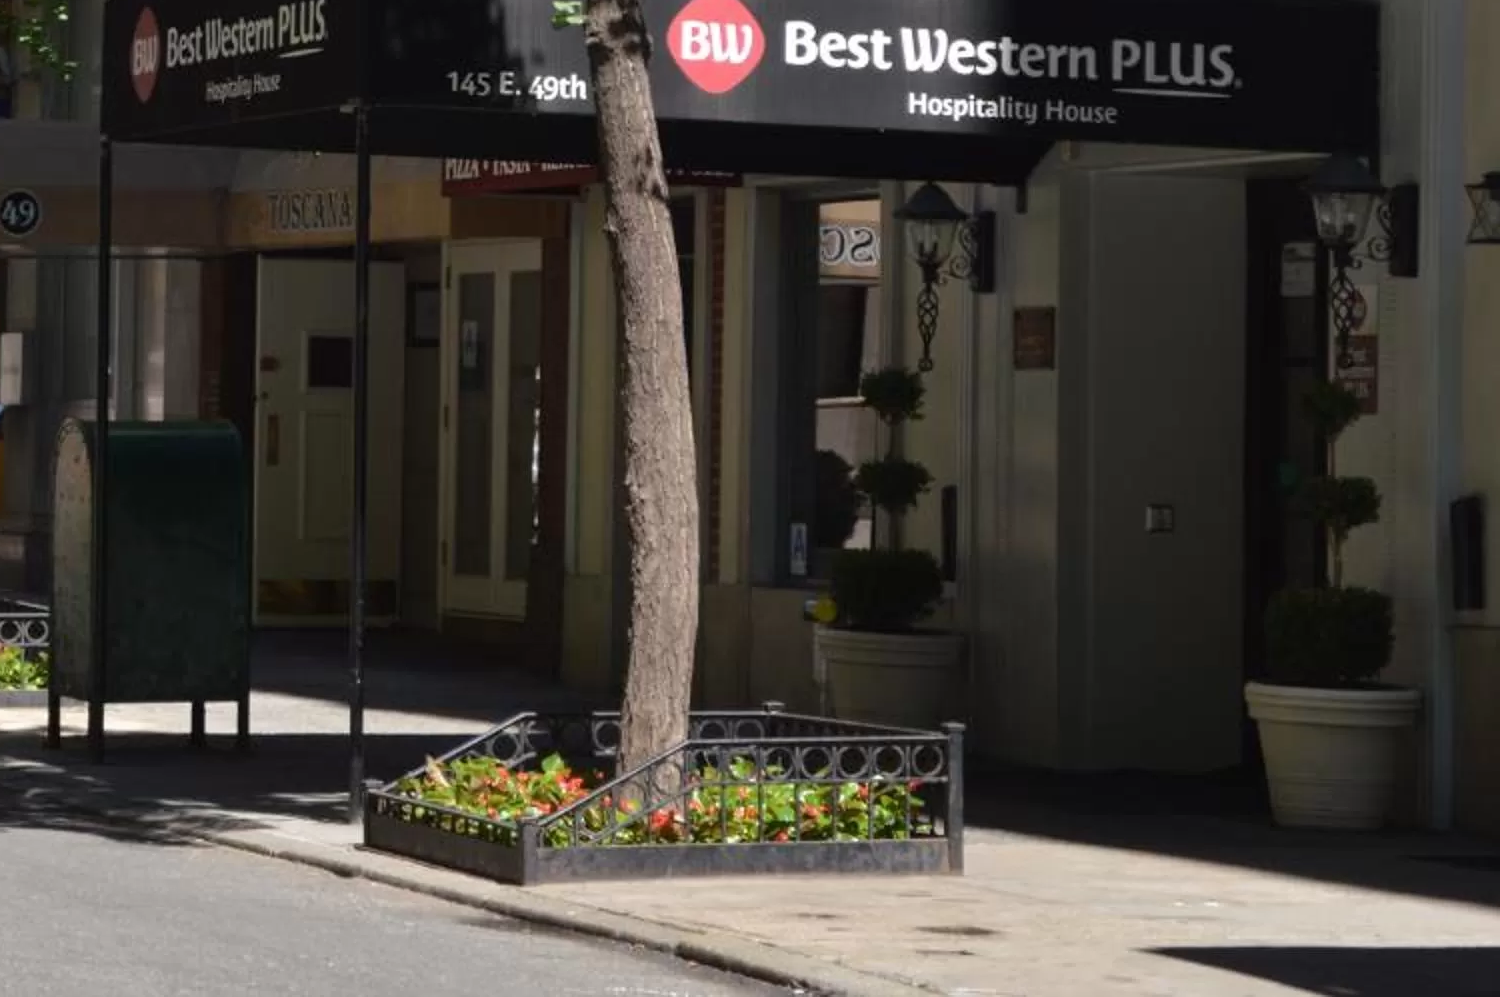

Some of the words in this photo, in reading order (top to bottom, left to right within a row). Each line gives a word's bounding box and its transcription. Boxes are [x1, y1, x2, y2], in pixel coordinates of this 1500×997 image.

[132, 34, 159, 77] BW
[166, 25, 203, 69] Best
[204, 14, 276, 61] Western
[680, 19, 754, 65] BW
[783, 19, 893, 72] Best
[900, 25, 1099, 81] Western
[1111, 38, 1237, 88] PLUS
[205, 73, 253, 104] Hospitality
[253, 72, 281, 94] House
[446, 70, 492, 97] 145
[499, 70, 522, 97] E.
[527, 72, 588, 101] 49th
[907, 91, 1037, 125] Hospitality
[1045, 99, 1119, 125] House
[3, 197, 36, 225] 49
[266, 189, 356, 231] TOSCANA
